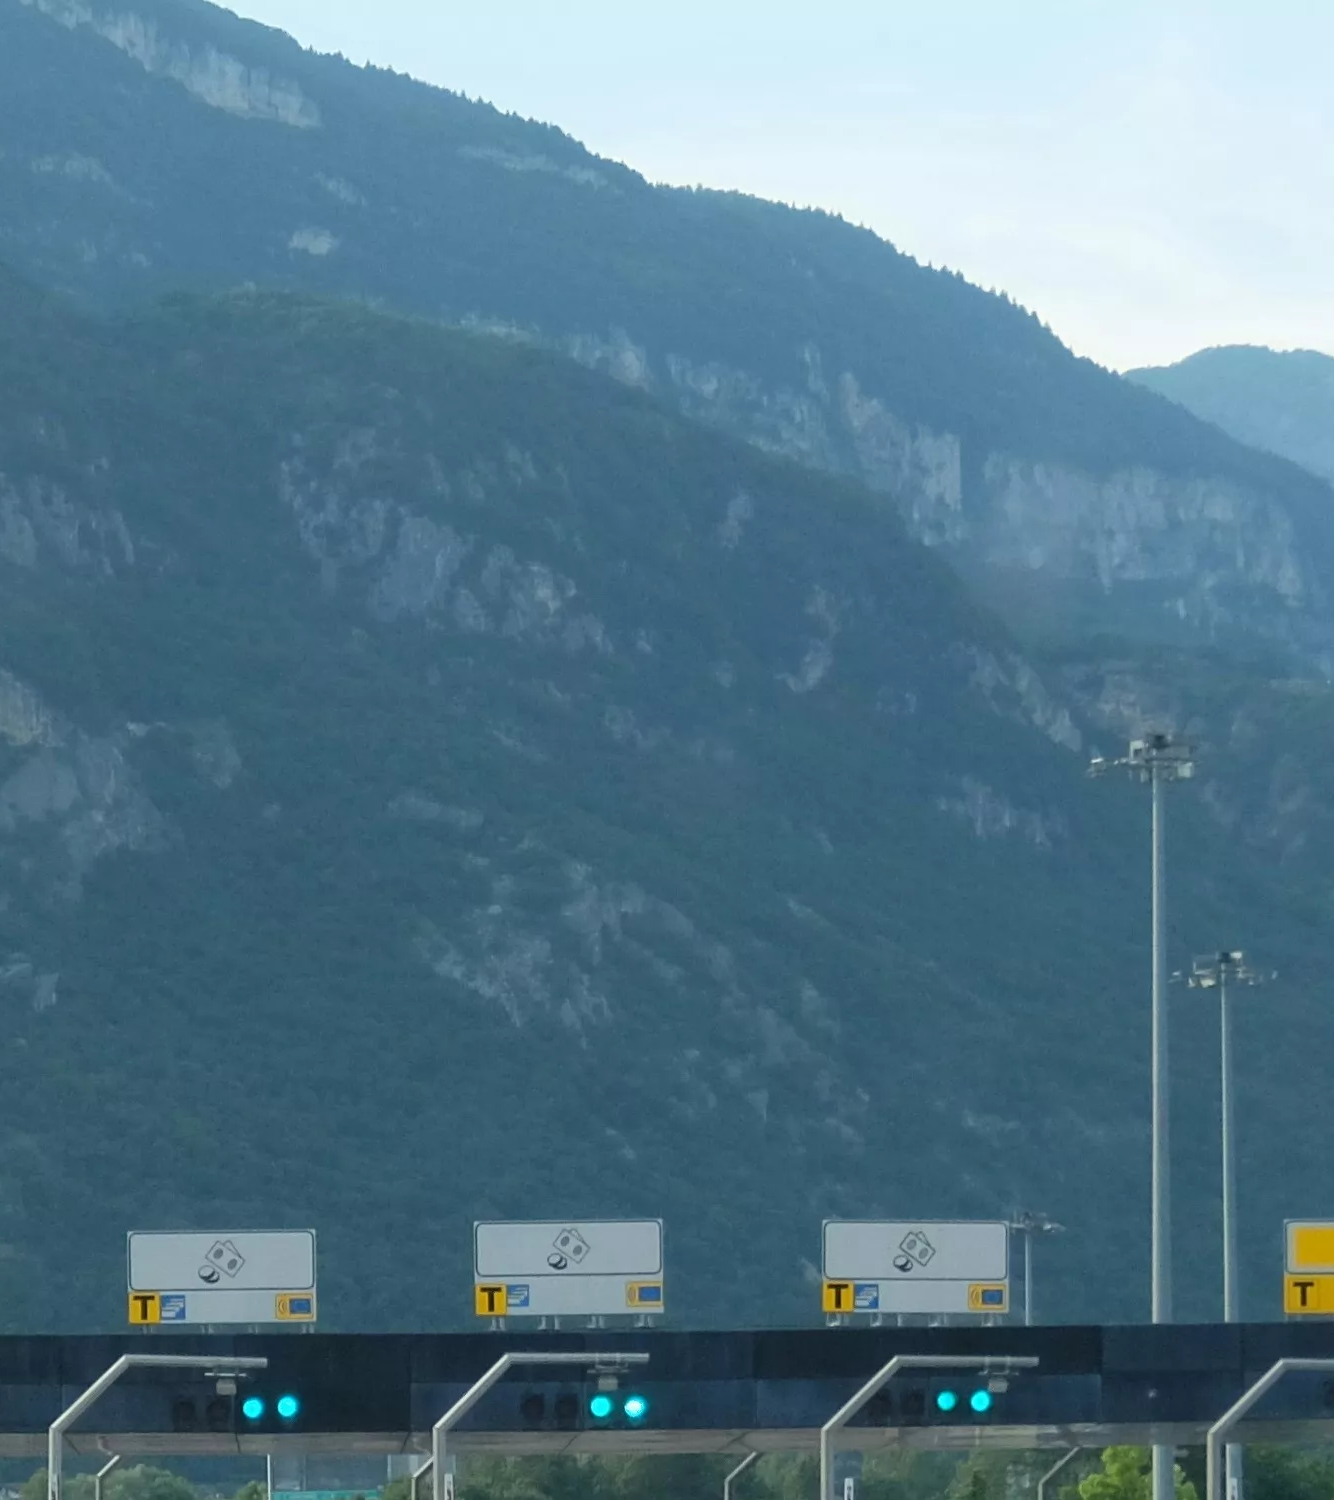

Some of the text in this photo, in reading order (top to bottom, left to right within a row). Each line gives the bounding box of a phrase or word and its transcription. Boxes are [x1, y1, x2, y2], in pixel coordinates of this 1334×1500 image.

[479, 1286, 502, 1312] T
[826, 1283, 849, 1309] T
[1292, 1281, 1315, 1307] T
[132, 1295, 156, 1321] T
